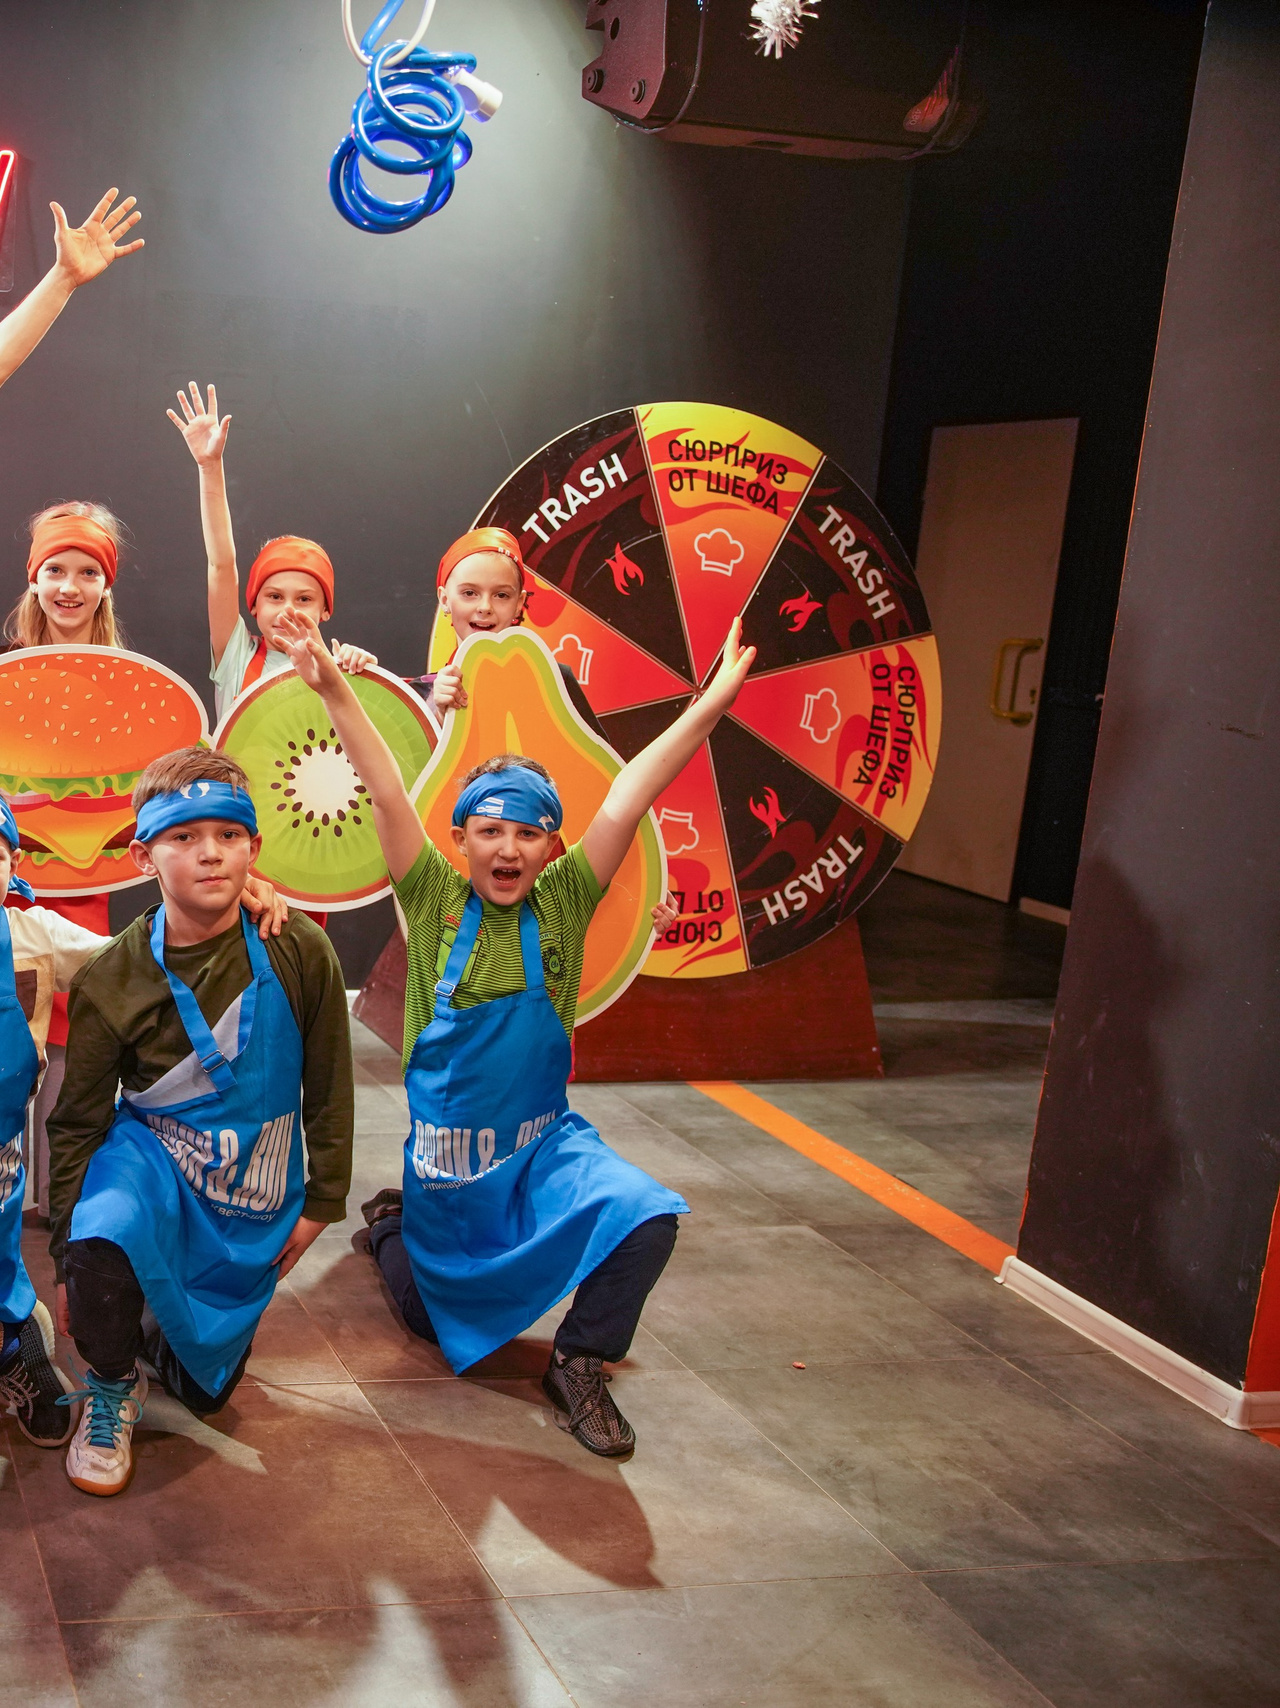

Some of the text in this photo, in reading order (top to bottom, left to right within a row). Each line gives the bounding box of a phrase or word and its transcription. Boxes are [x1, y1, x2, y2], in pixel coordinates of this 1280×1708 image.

[522, 452, 629, 544] TRASH
[667, 439, 789, 485] СЮРПРИЗ
[668, 468, 781, 513] ОТ ШЕФА
[818, 505, 897, 620] TRASH
[853, 663, 892, 786] ОТ ШЕФА
[879, 665, 916, 800] СЮРПРИЗ
[693, 889, 724, 914] ОТ
[761, 835, 864, 926] TRASH
[230, 1110, 296, 1213] RUN
